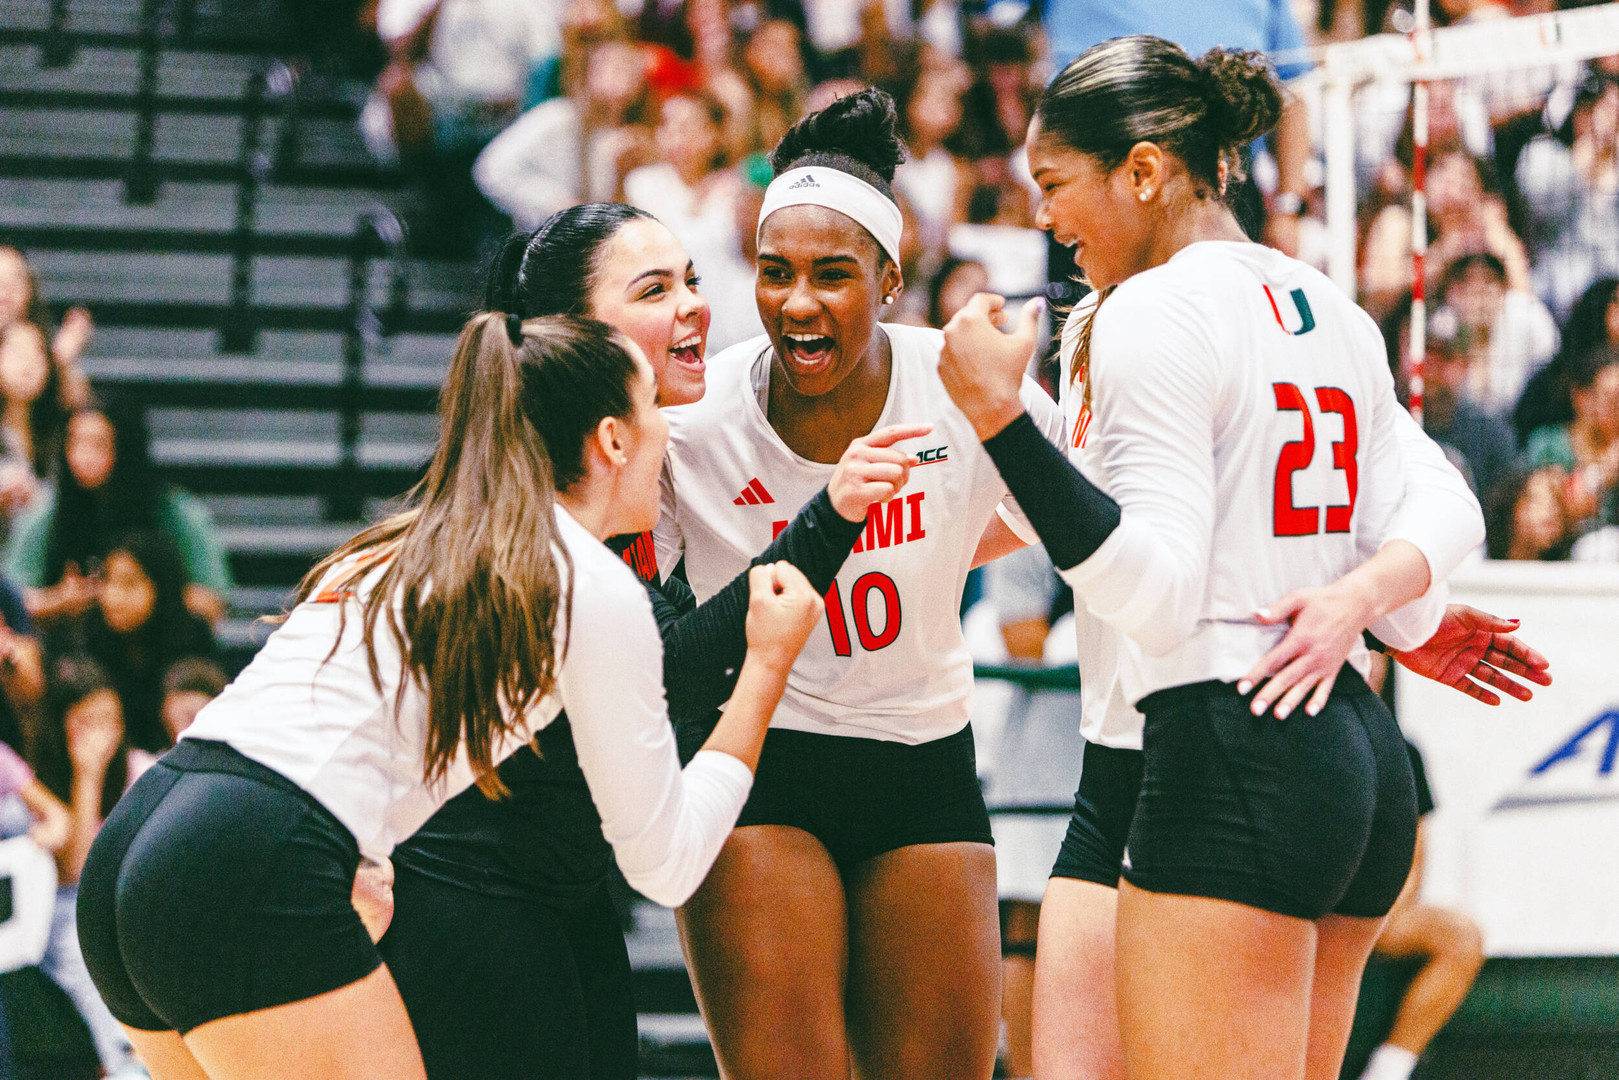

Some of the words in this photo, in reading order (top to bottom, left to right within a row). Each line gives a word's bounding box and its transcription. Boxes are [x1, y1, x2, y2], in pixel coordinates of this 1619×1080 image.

[1262, 284, 1316, 336] U
[1272, 382, 1359, 537] 23
[824, 571, 902, 658] 10
